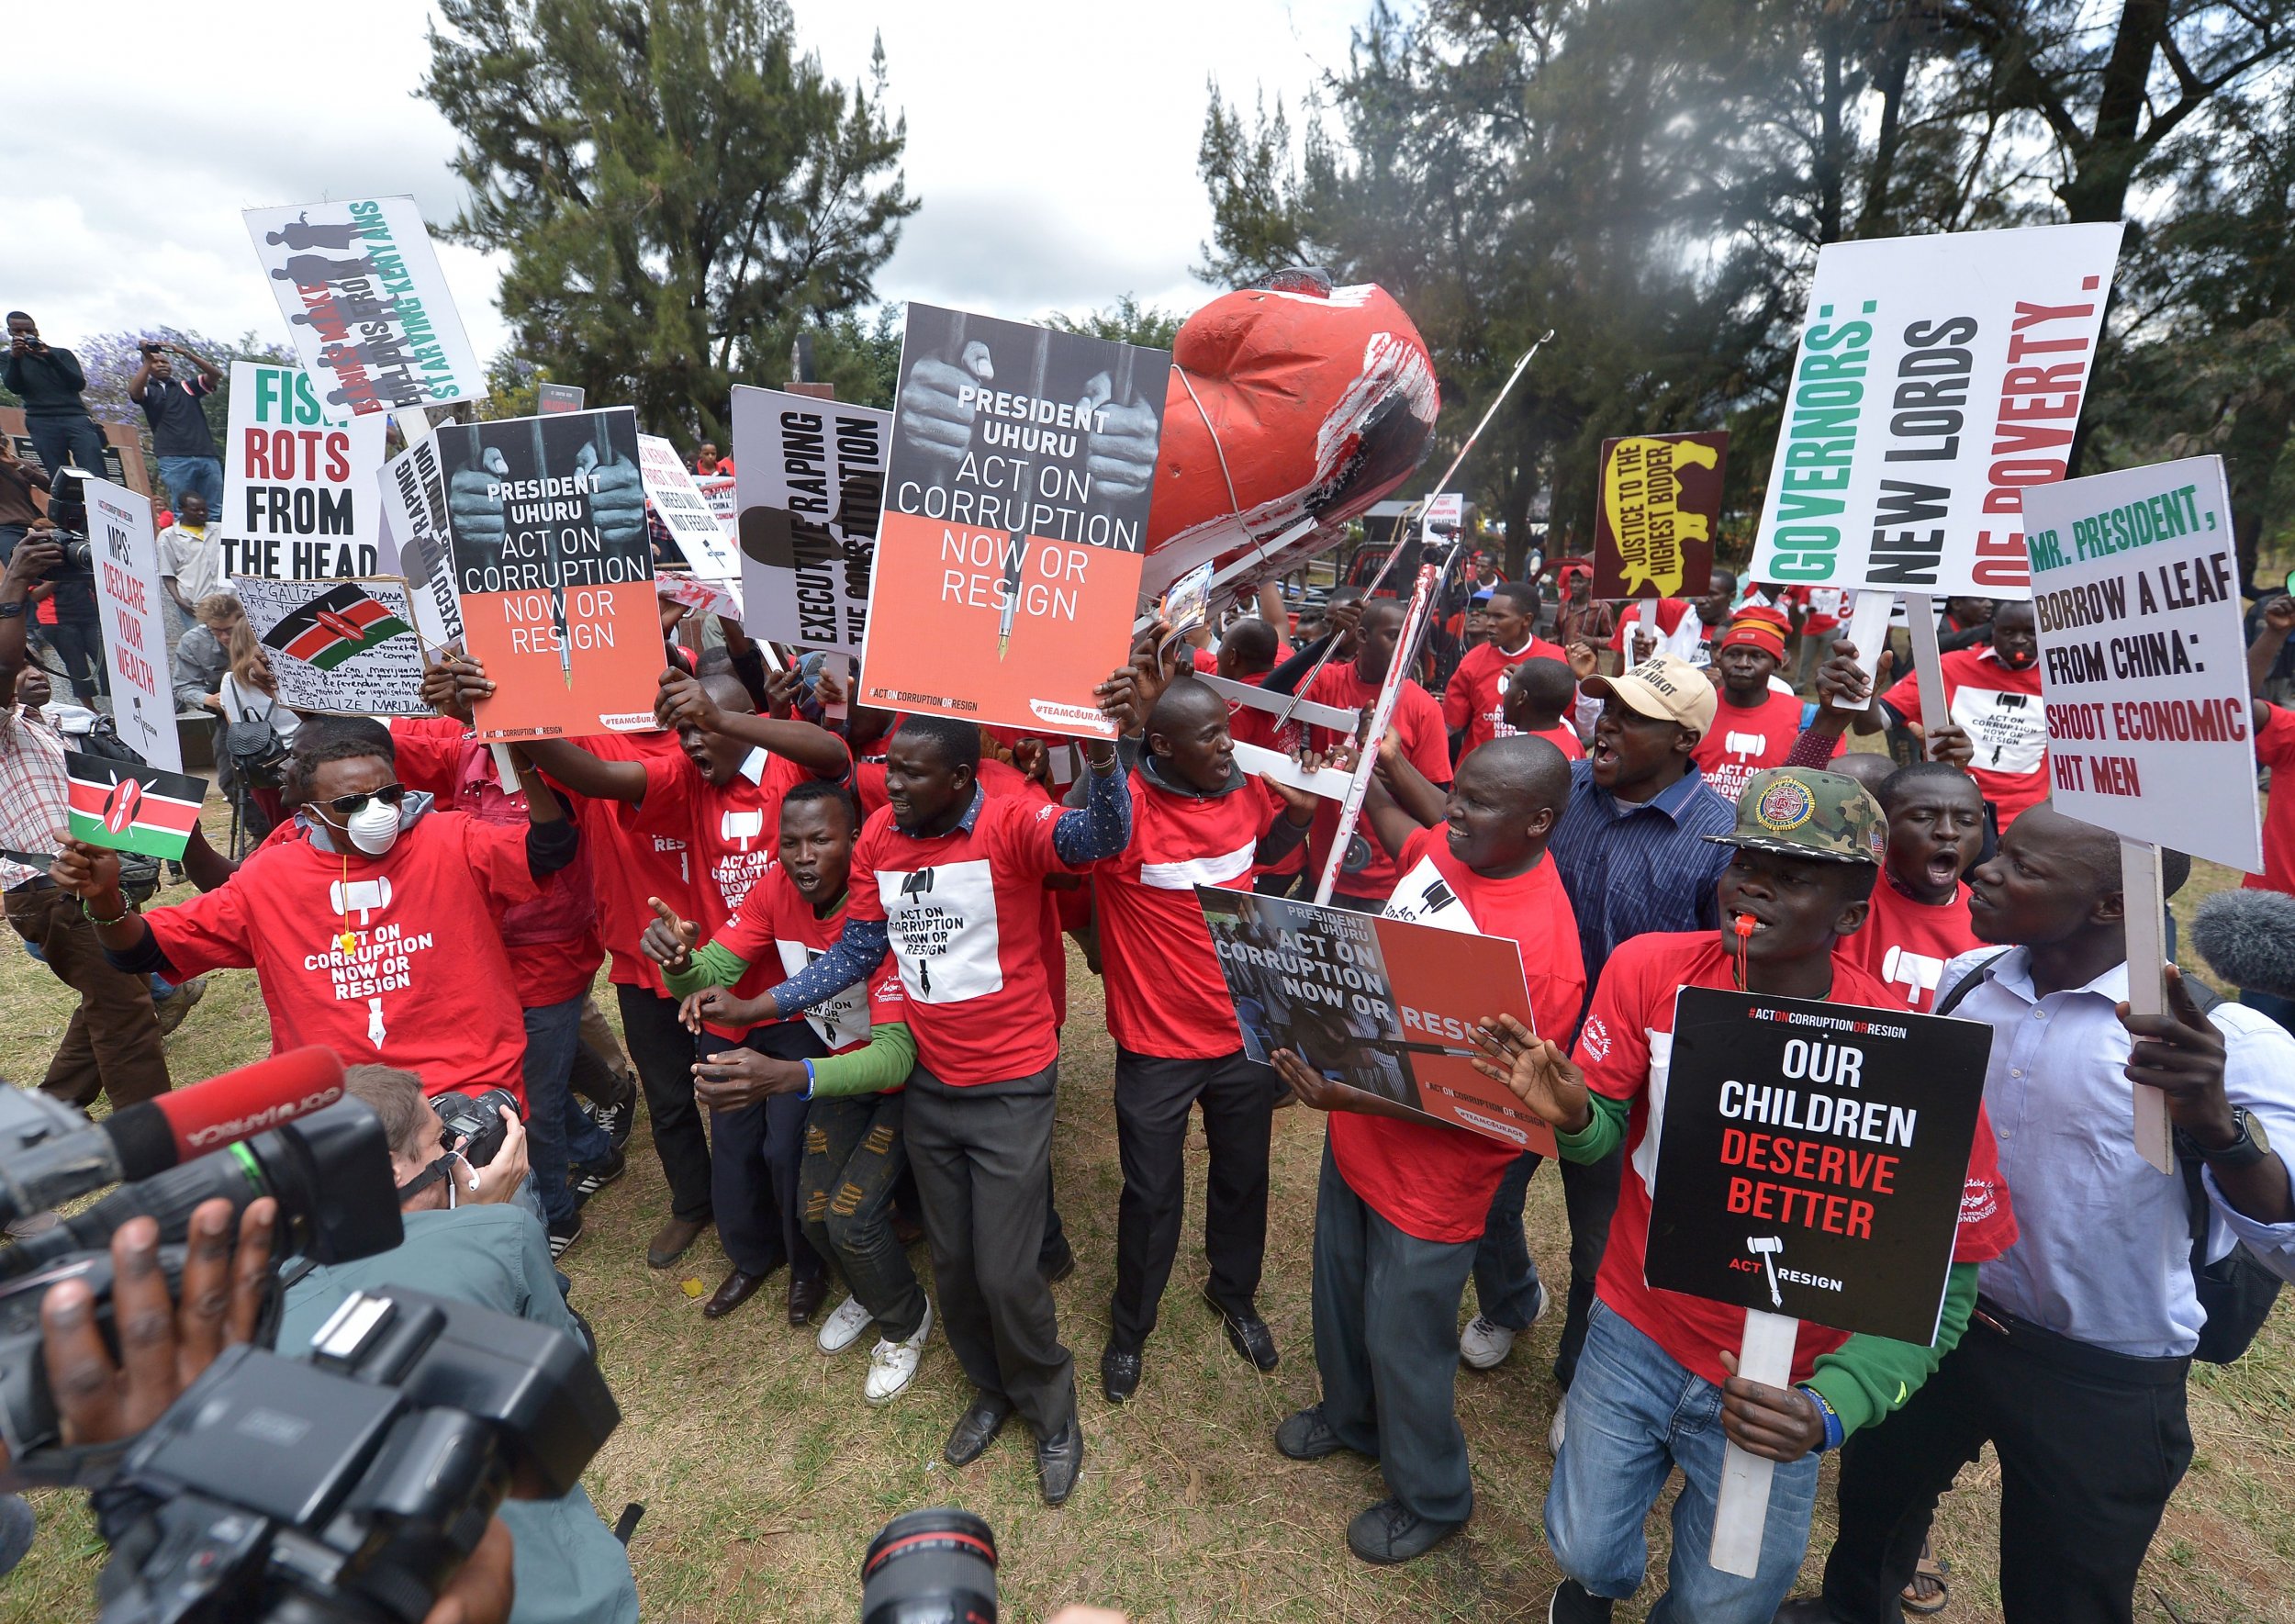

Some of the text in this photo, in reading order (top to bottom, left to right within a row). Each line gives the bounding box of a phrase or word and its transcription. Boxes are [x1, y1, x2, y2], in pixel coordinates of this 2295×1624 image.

[349, 200, 460, 400] STARVING KENYANS
[296, 279, 383, 416] BANKS MAKE
[341, 259, 422, 409] BILLIONS FROM
[256, 369, 348, 428] FIS
[957, 385, 1110, 435] PRESIDENT
[245, 428, 350, 482] ROTS
[983, 420, 1077, 459] UHURU
[1769, 299, 1877, 581] GOVERNORS:
[1865, 316, 1978, 585] NEW LORDS
[395, 457, 430, 536] RAPING
[487, 475, 600, 502] PRESIDENT
[956, 451, 1091, 504] ACT ON
[246, 487, 353, 535] FROM
[511, 500, 582, 524] UHURU
[655, 490, 687, 509] GREED
[898, 481, 1138, 553] CORRUPTION
[1617, 444, 1647, 566] JUSTICE TO THE
[1646, 444, 1675, 577] HIGHEST BIDDER
[668, 514, 690, 531] NOT
[780, 411, 838, 644] EXECUTIVE RAPING
[2028, 484, 2216, 574] MR. PRESIDENT,
[106, 523, 132, 567] MPS:
[221, 538, 378, 580] THE HEAD
[501, 526, 601, 559] ACT ON
[940, 528, 1090, 584] NOW OR
[103, 561, 148, 616] DECLARE
[465, 555, 646, 594] CORRUPTION
[2034, 551, 2231, 633] BORROW A LEAF
[251, 598, 267, 610] ASK
[369, 590, 402, 601] JUANA
[503, 590, 616, 623] NOW OR
[941, 569, 1078, 622] RESIGN
[116, 606, 144, 653] YOUR
[511, 622, 615, 655] RESIGN
[115, 643, 156, 697] WEALTH
[1645, 658, 1667, 674] DR.
[2045, 629, 2205, 686] FROM CHINA:
[868, 687, 978, 711] #ACTONCORRUPTIONORRESIGN
[1642, 671, 1678, 697] AUKOT
[286, 692, 436, 715] LEGALIZE MARIJUANA
[606, 714, 657, 725] #TEAMCOURA
[2045, 697, 2245, 743] SHOOT ECONOMIC
[482, 726, 563, 739] #ACTONCORRUPTIONORRESIGN
[1972, 719, 2038, 734] CORRUPTION
[1983, 727, 2007, 736] NOW
[1983, 734, 2021, 745] RESIGN
[1701, 772, 1750, 787] CORRUP
[1718, 763, 1743, 776] ACT
[2054, 754, 2142, 798] HIT MEN
[1712, 784, 1743, 797] NOW
[655, 837, 687, 852] RES
[721, 849, 768, 870] ACT ON
[720, 880, 751, 897] NOW
[890, 917, 964, 934] CORRUPTION
[900, 906, 944, 920] ACT ON
[1286, 904, 1366, 930] PRESIDENT
[375, 923, 401, 943] ON
[902, 931, 948, 944] NOW OR
[905, 944, 947, 956] RESIGN
[1280, 929, 1377, 969] ACT ON
[1319, 922, 1369, 943] UHURU
[304, 933, 433, 971] CORRUPTION
[331, 956, 411, 984] NOW OR
[1215, 938, 1384, 996] CORRUPTION
[335, 971, 411, 1001] RESIGN
[1282, 975, 1499, 1048] NOW OR RESI
[1749, 1007, 1907, 1039] #ACTONCORRUPTIONORRESIGN
[1782, 1038, 1864, 1089] OUR
[1425, 1081, 1547, 1129] #ACTONCORRUPTIONORRESIGN
[1718, 1080, 1917, 1148] CHILDREN
[1720, 1127, 1899, 1195] DESERVE
[1726, 1177, 1875, 1240] BETTER
[1958, 1204, 1998, 1223] OMMISSION
[1729, 1258, 1842, 1293] ACT RESIGN
